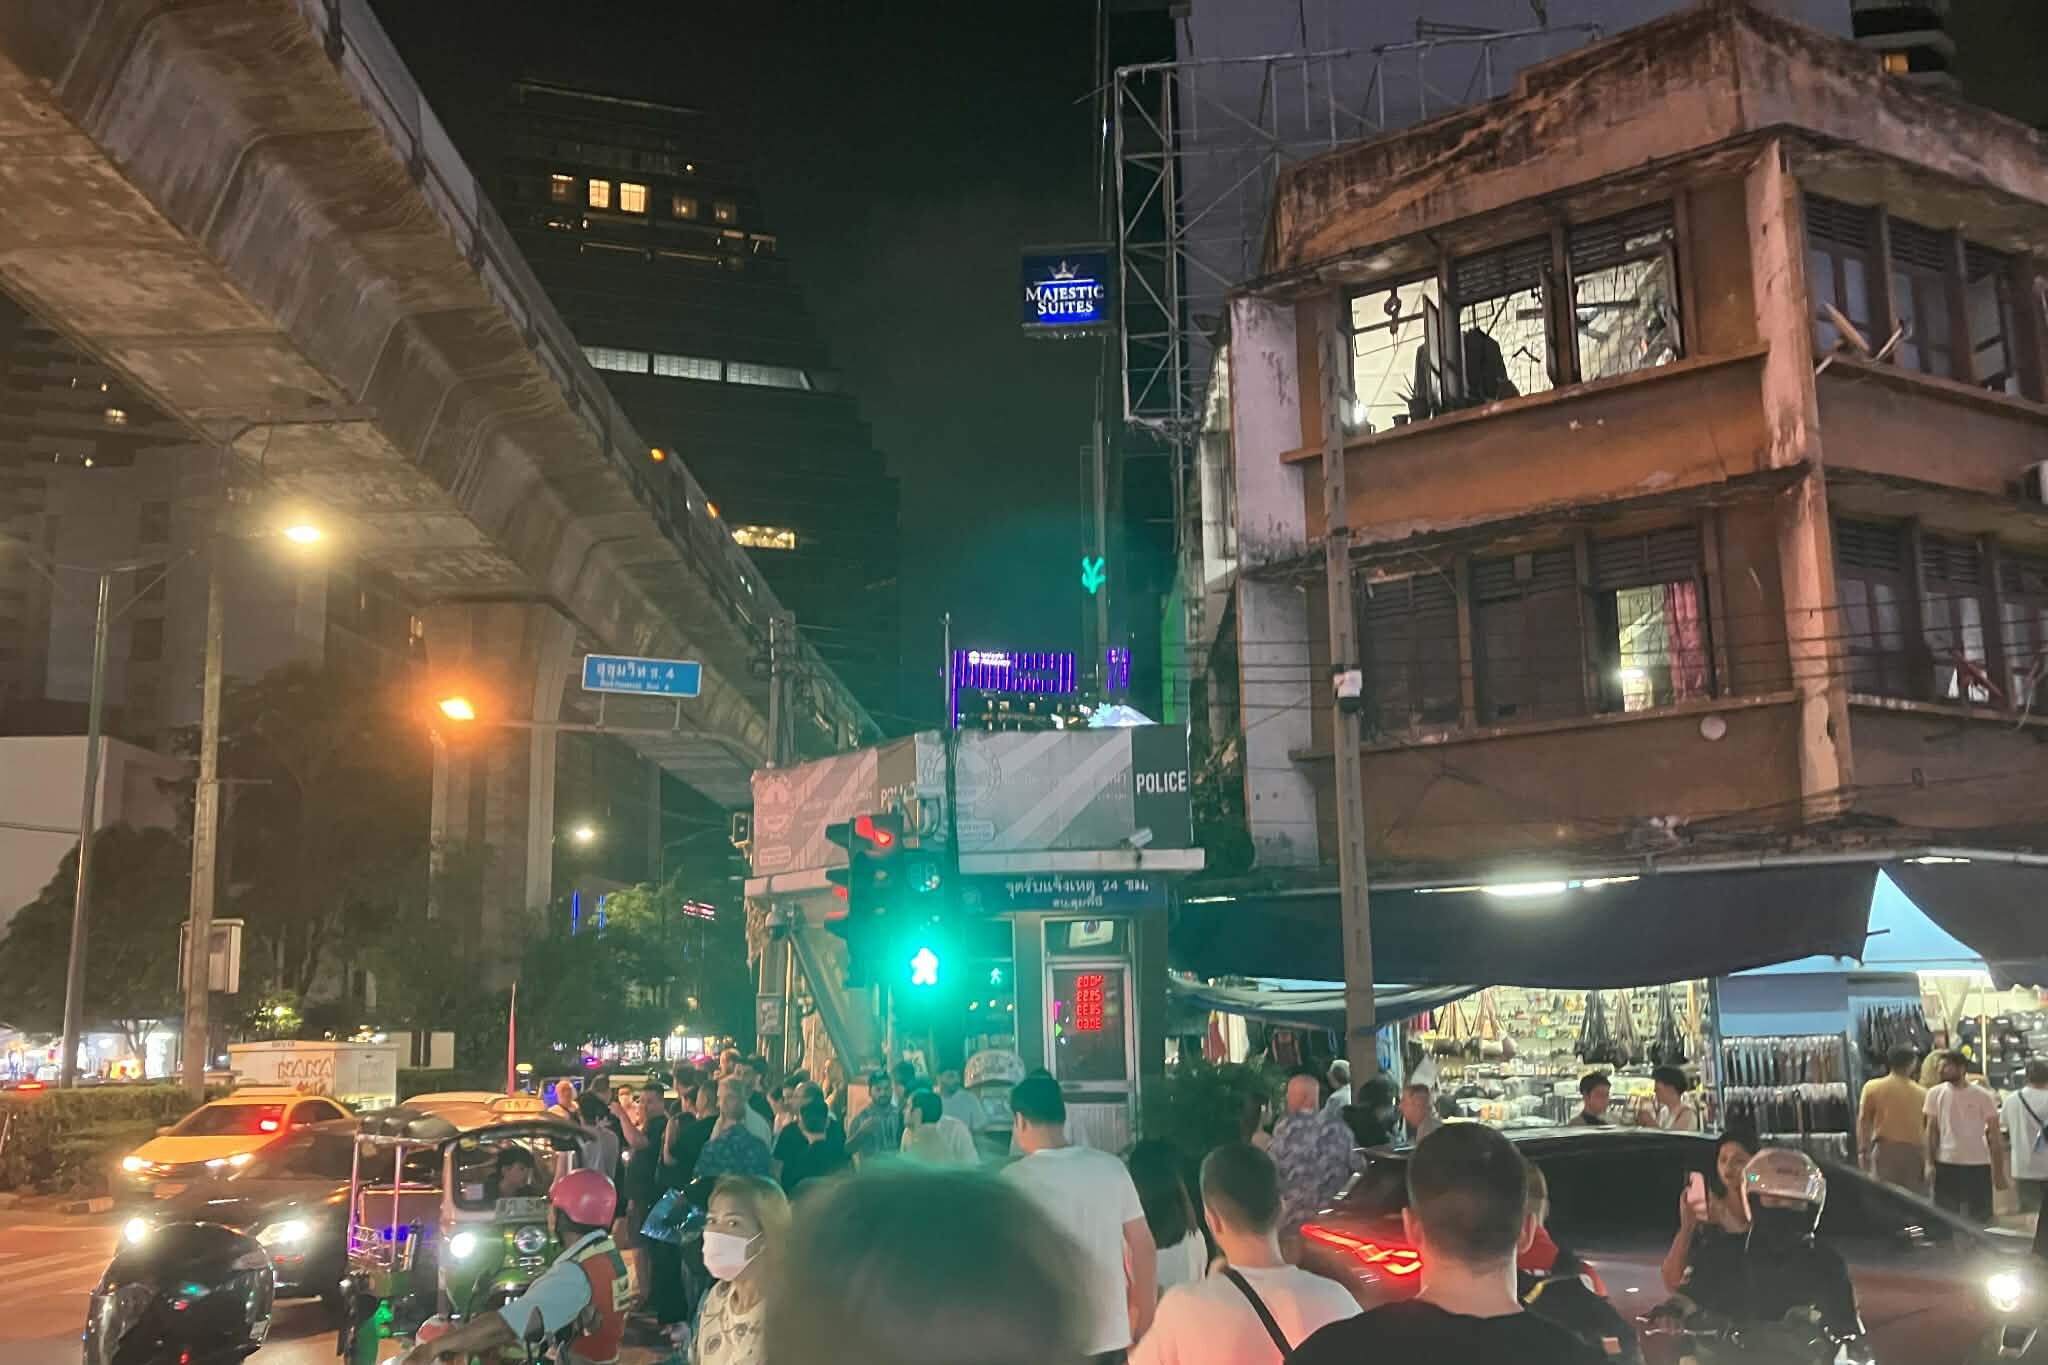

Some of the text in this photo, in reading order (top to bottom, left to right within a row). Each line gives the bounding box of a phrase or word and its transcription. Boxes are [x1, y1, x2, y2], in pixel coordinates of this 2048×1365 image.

[1025, 285, 1104, 304] MAJESTIC
[1037, 300, 1094, 315] SUITES
[665, 667, 675, 680] 4
[1136, 770, 1187, 795] POLICE
[1102, 880, 1118, 892] 24
[278, 1057, 332, 1079] NANA
